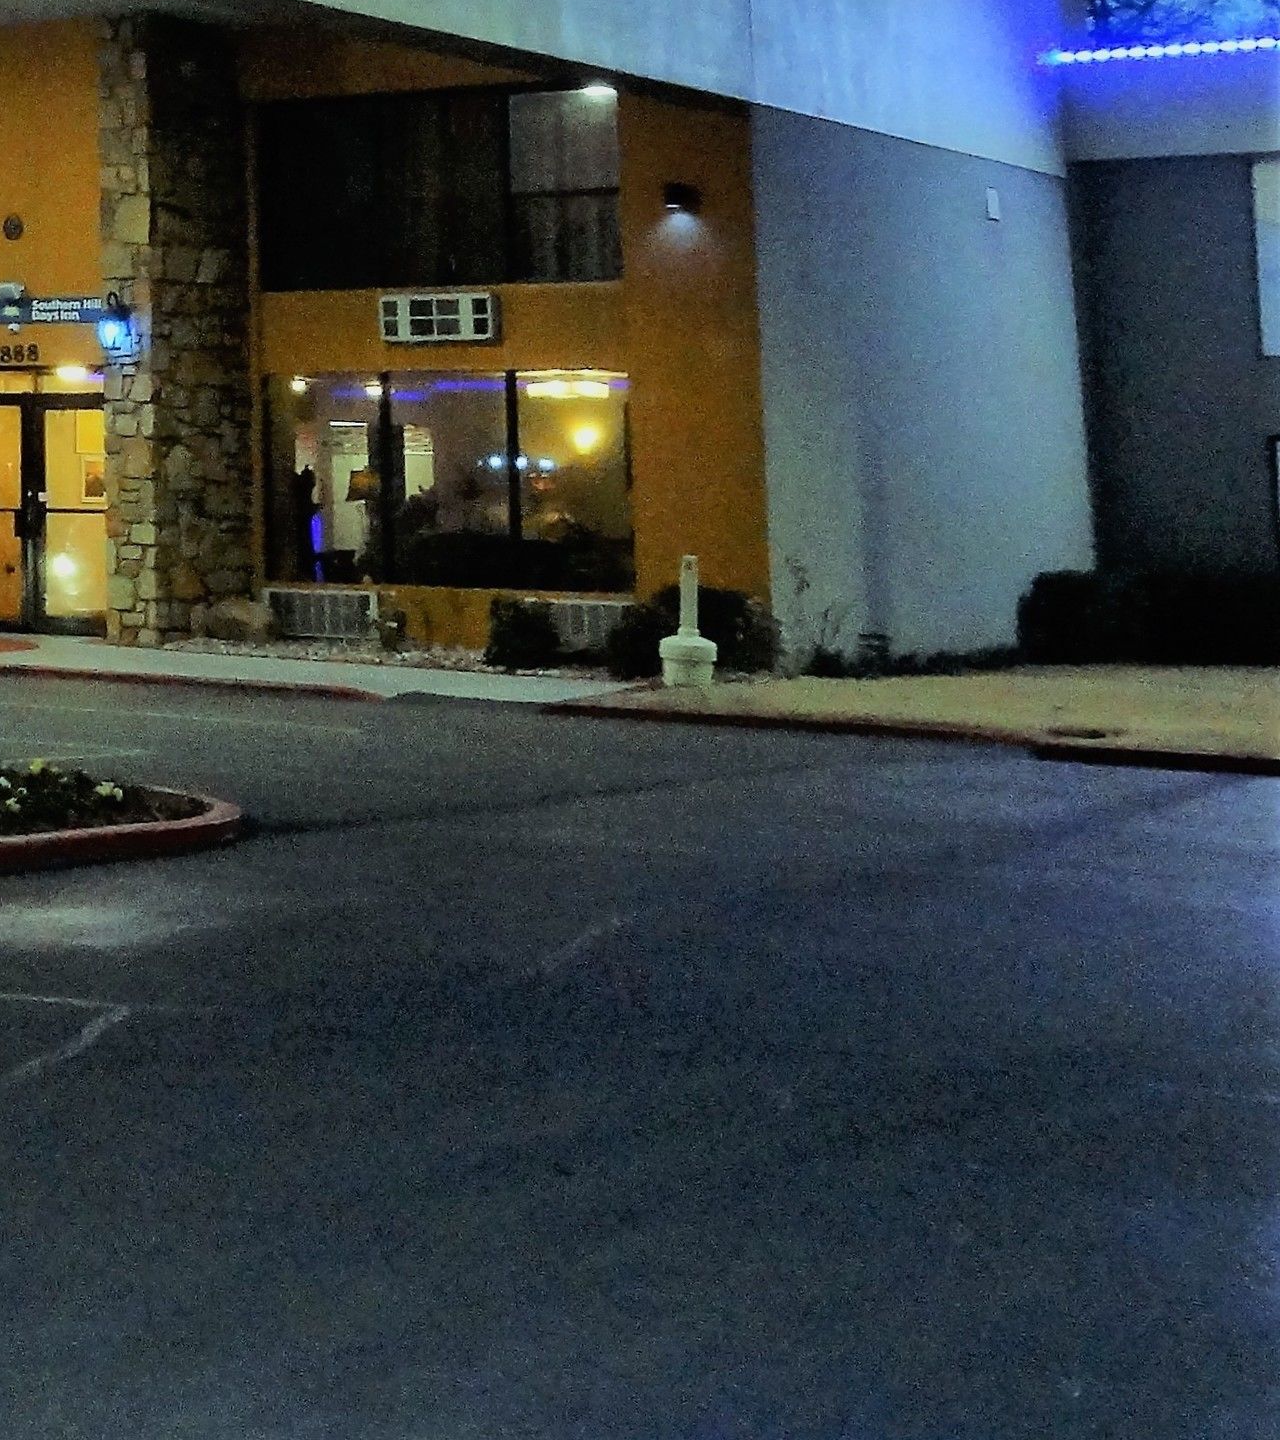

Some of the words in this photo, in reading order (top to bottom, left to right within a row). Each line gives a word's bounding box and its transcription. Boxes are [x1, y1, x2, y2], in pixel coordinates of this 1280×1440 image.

[32, 299, 81, 310] Southern
[31, 310, 59, 322] Days
[60, 310, 80, 321] Inn
